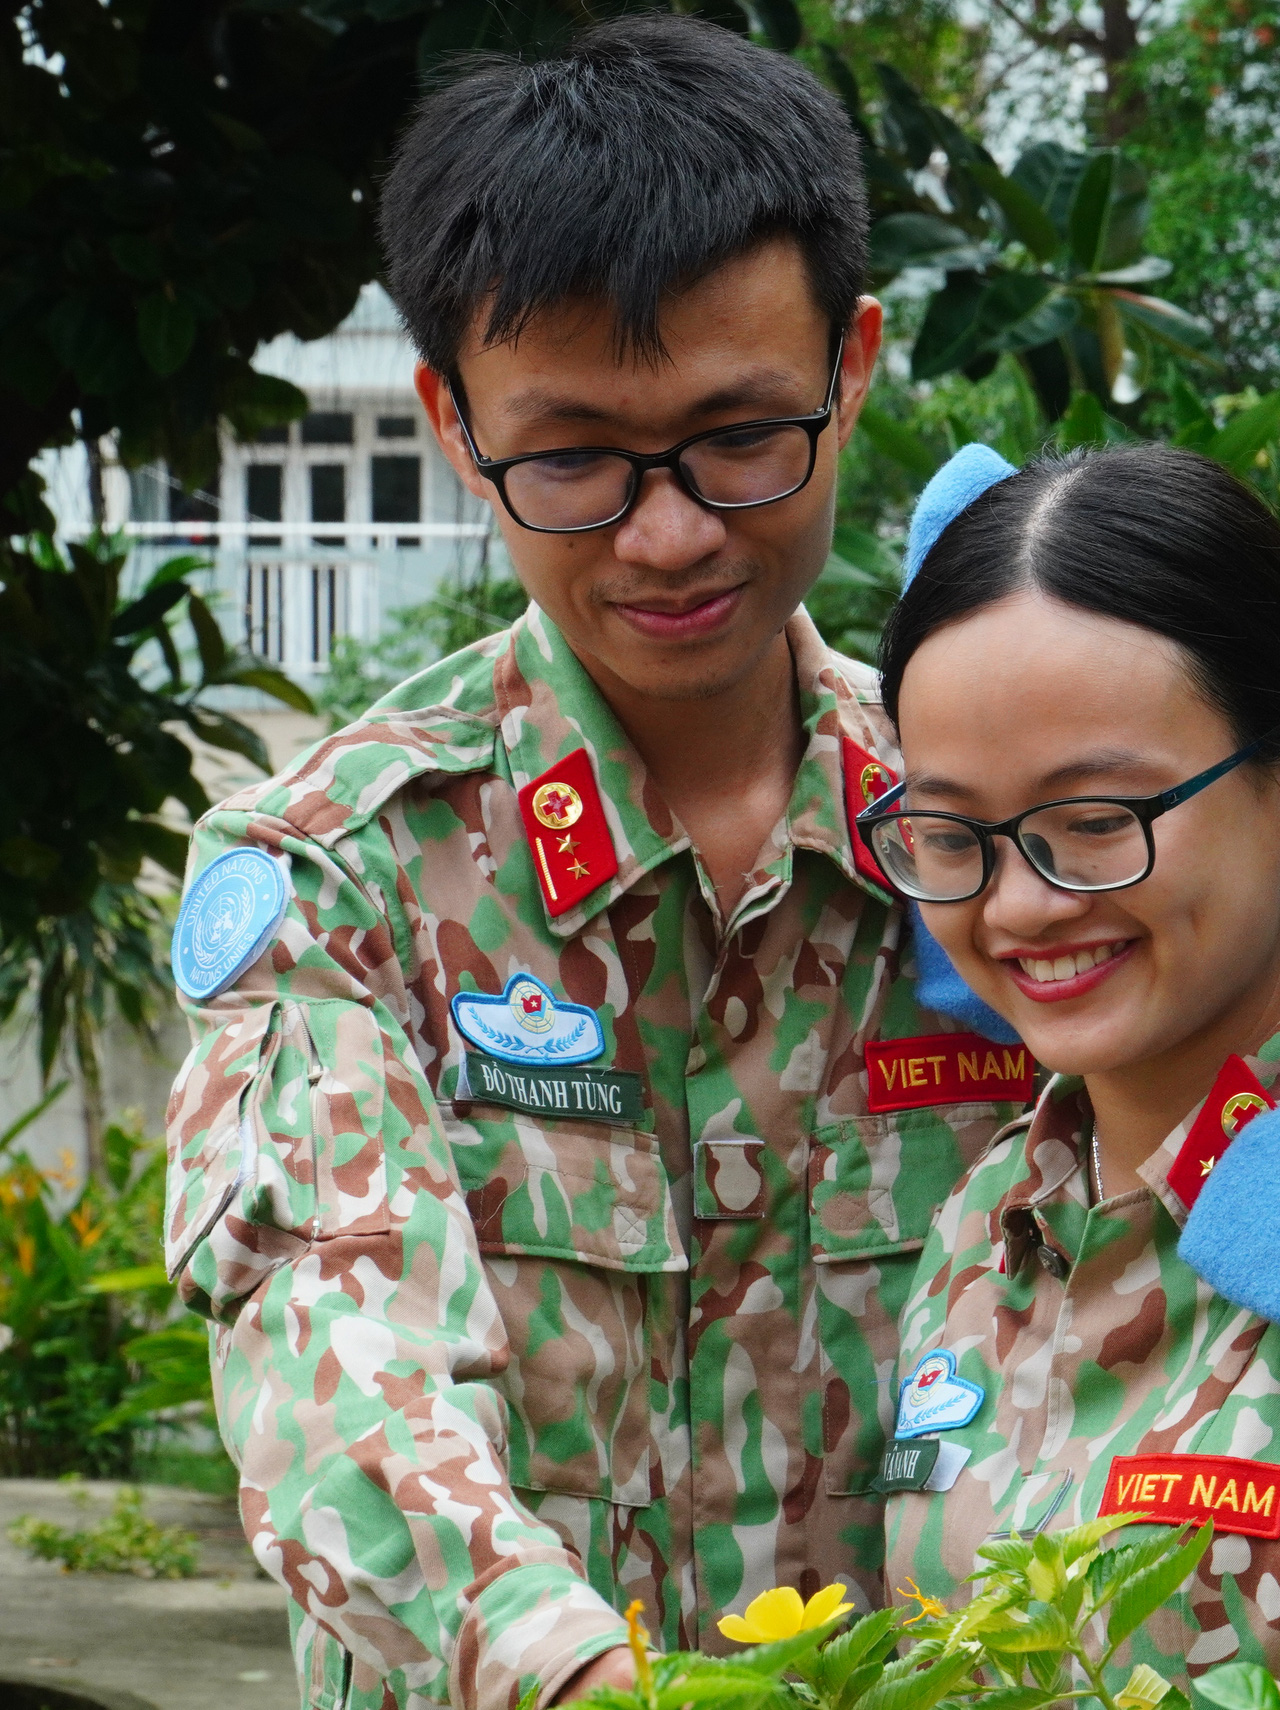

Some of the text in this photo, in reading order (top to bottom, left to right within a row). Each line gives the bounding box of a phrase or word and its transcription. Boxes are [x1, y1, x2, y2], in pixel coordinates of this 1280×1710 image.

[187, 858, 268, 926] UNITED NATIONS
[189, 932, 255, 986] NATIONS UNIES
[877, 1049, 1025, 1091] VIET NAM
[504, 1072, 569, 1109] THANH
[571, 1073, 622, 1114] TÙNG
[1117, 1473, 1276, 1518] VIET NAM
